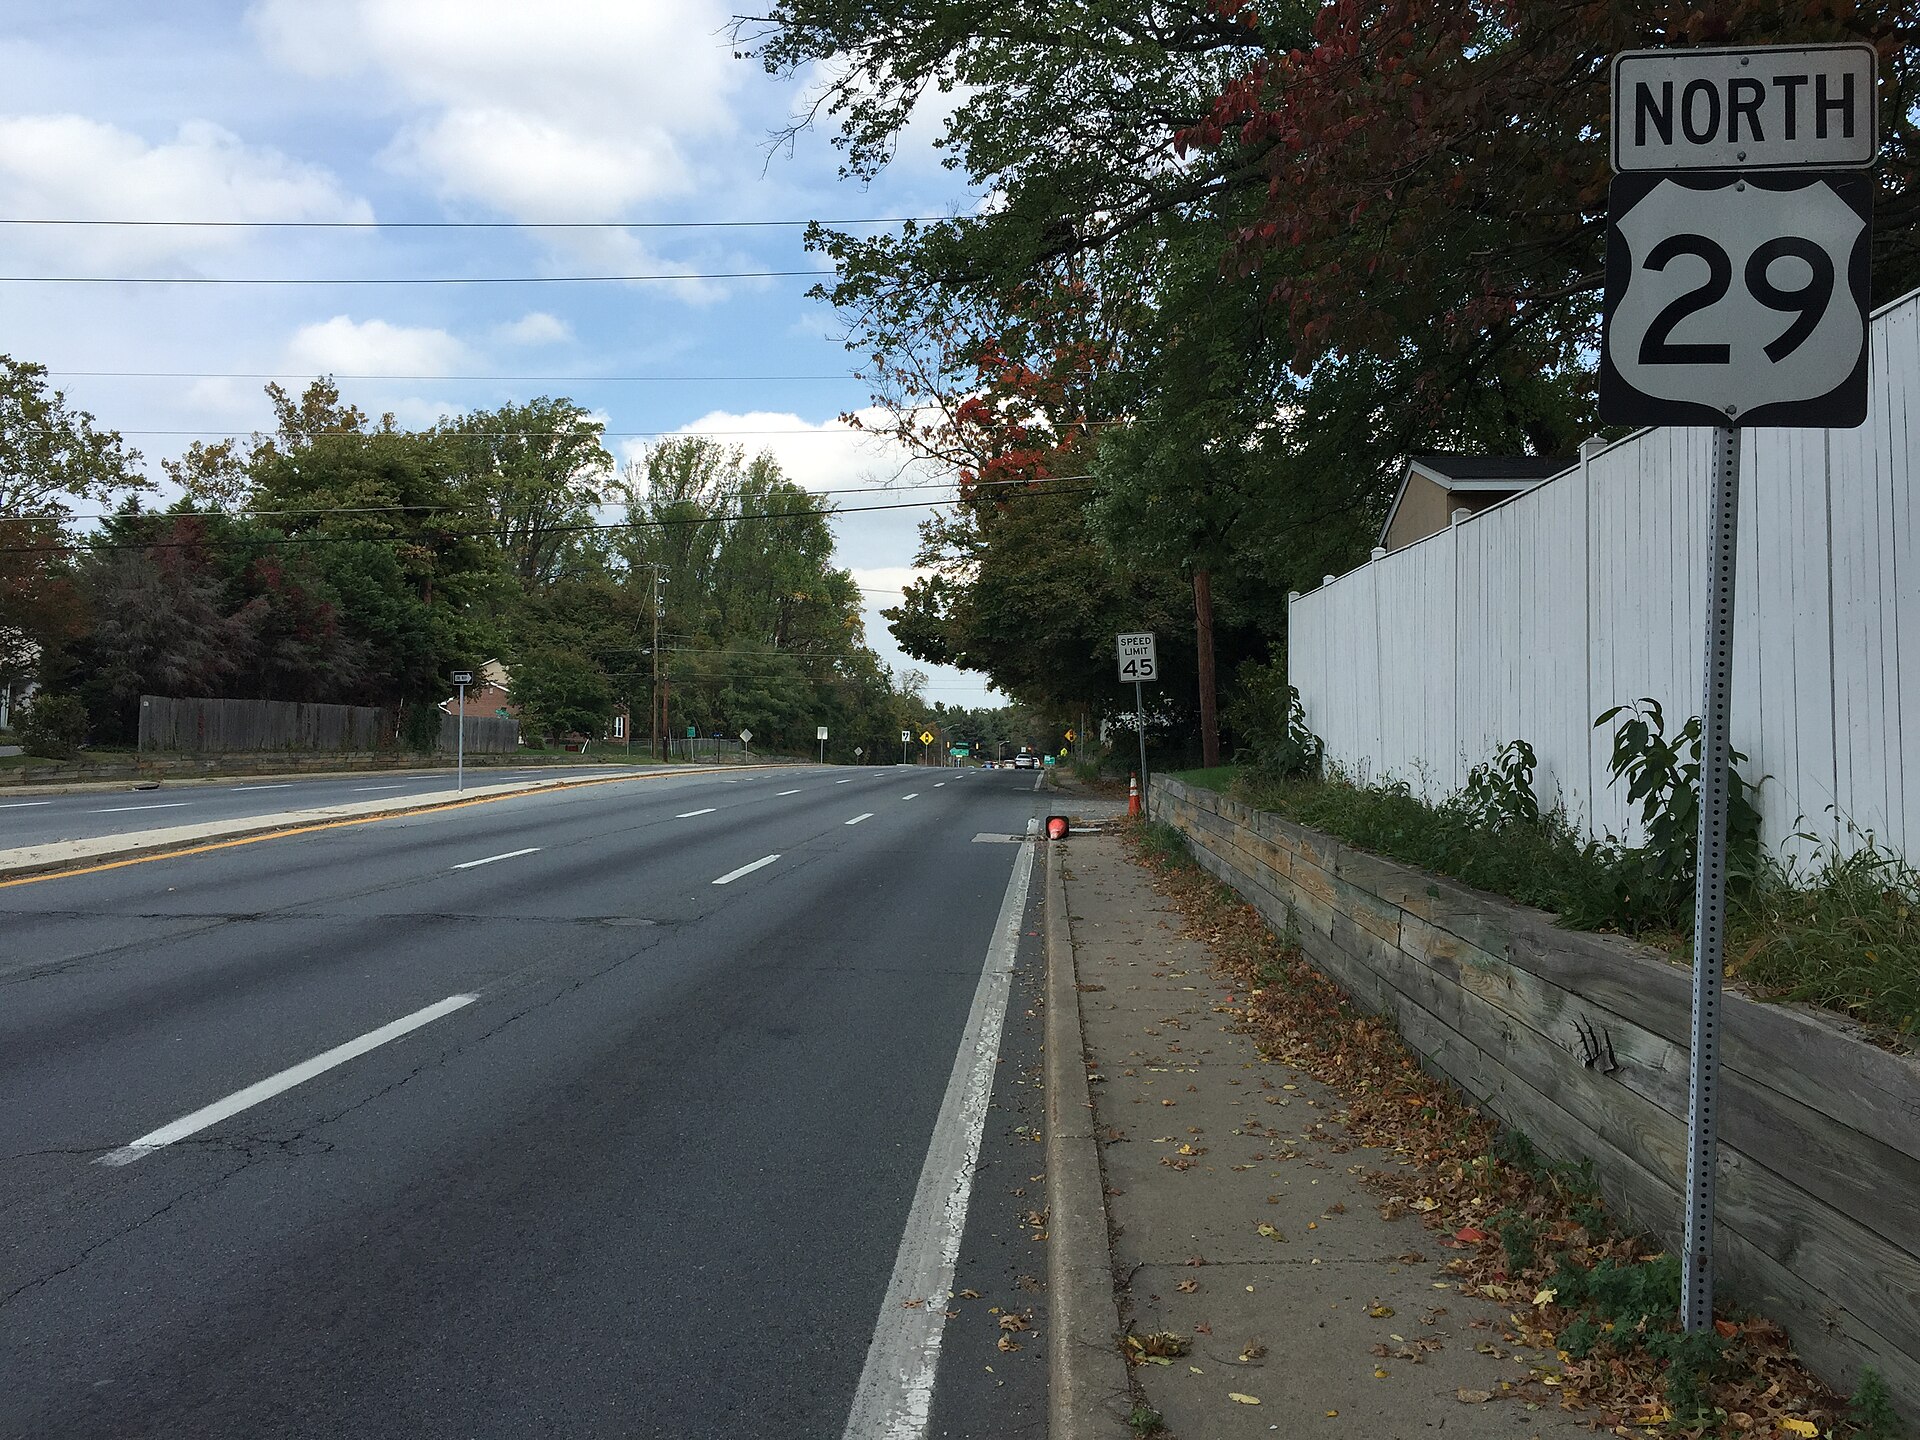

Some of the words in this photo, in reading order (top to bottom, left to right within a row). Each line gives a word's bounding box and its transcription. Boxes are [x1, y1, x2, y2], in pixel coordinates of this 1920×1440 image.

[1634, 73, 1855, 146] NORTH
[1637, 233, 1835, 365] 29
[1121, 637, 1151, 646] SPEED
[1125, 647, 1148, 655] LIMIT
[1123, 659, 1153, 676] 45
